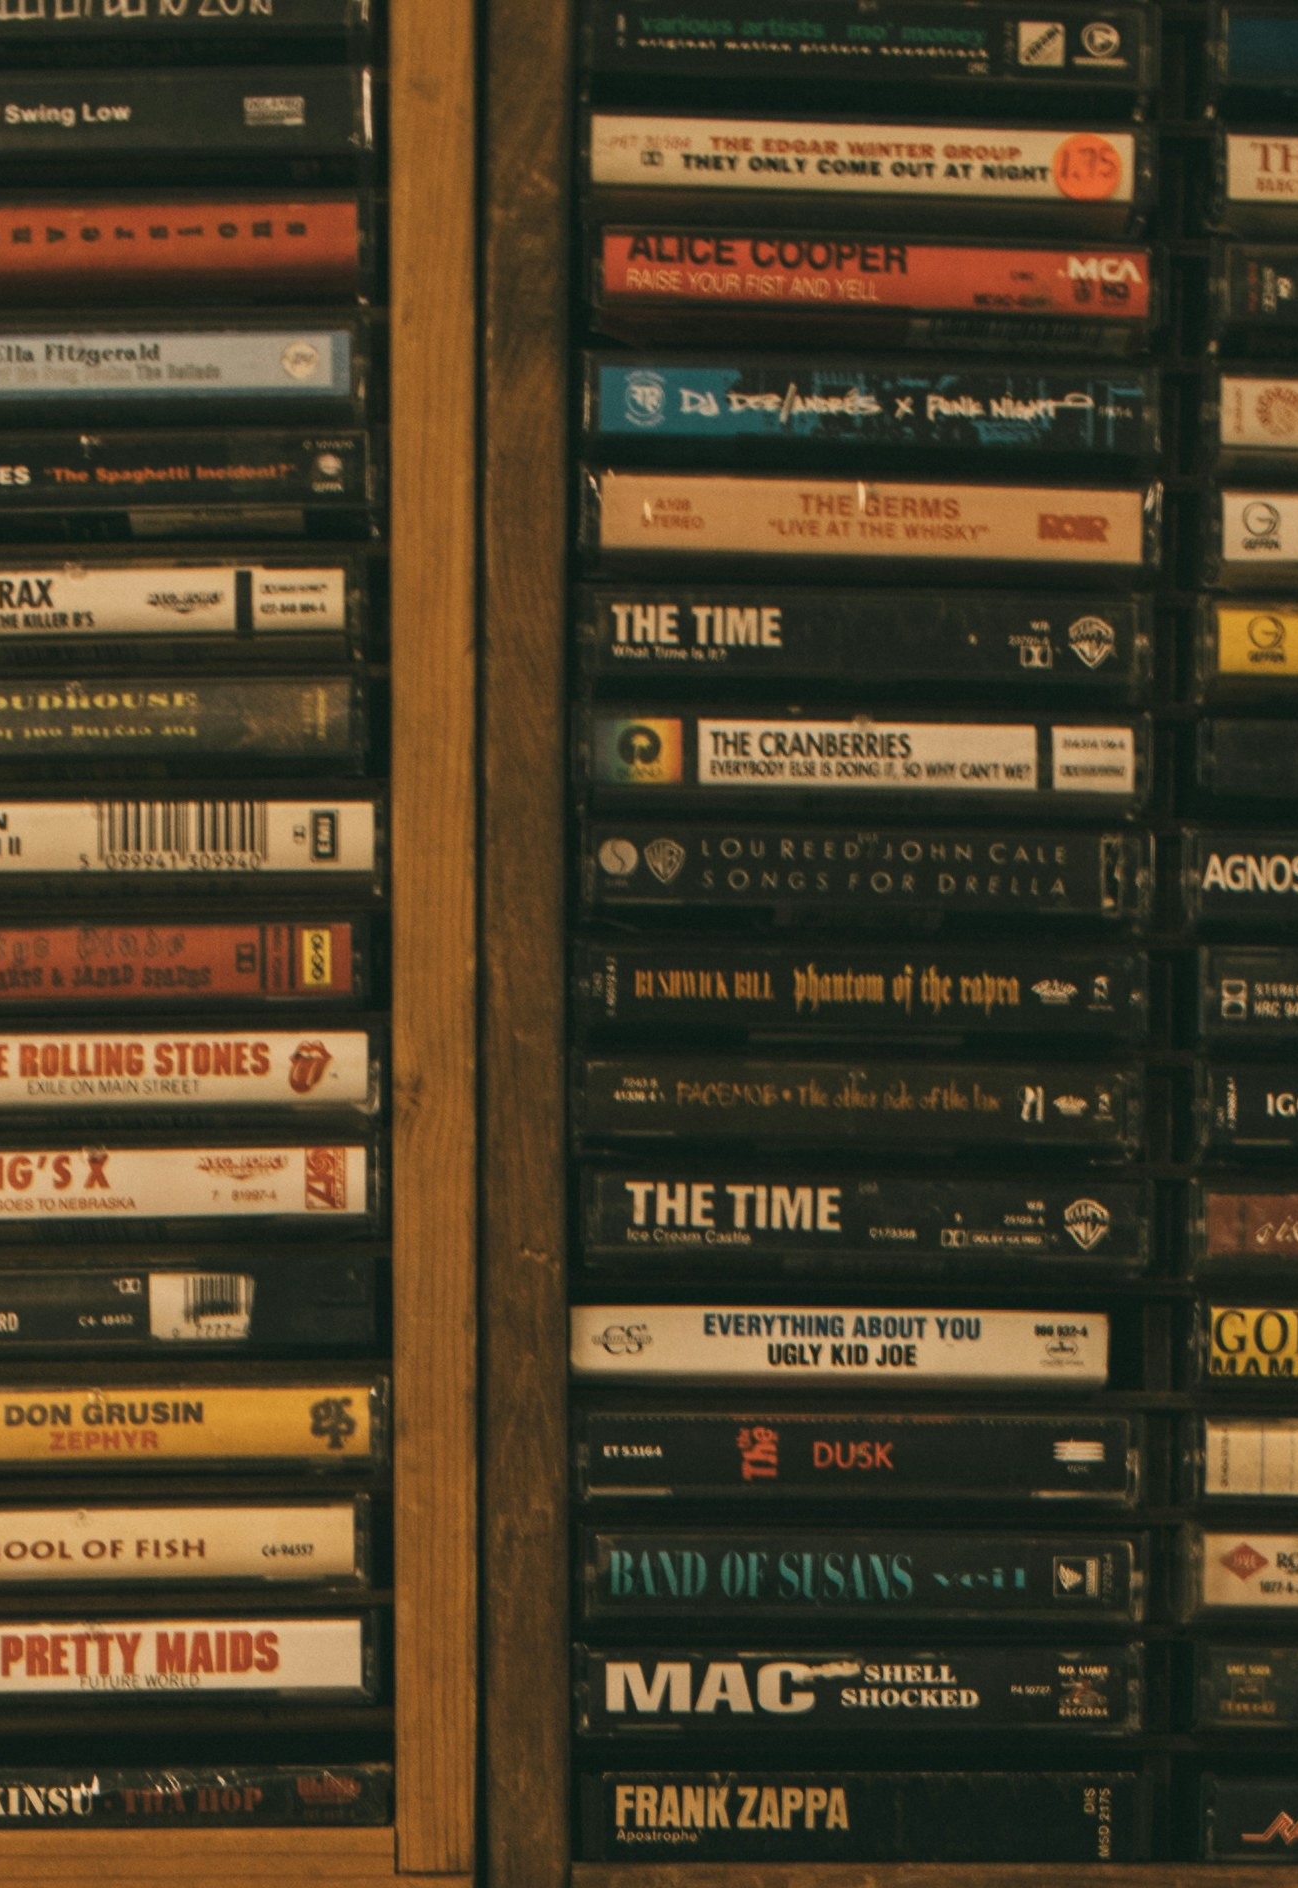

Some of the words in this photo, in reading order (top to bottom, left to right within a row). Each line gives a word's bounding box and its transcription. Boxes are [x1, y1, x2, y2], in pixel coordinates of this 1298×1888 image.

[4, 102, 73, 129] Swing
[79, 103, 130, 123] Low
[682, 154, 742, 172] THEY
[749, 155, 811, 175] ONLY
[818, 158, 885, 178] COME
[891, 159, 937, 178] OUT
[943, 161, 975, 179] AT
[981, 162, 1050, 183] NIGHT
[21, 612, 69, 629] KILLER
[612, 604, 683, 644] THE
[692, 605, 782, 647] TIME
[711, 731, 754, 756] THE
[759, 731, 911, 758] CRANBERRIES
[8, 836, 21, 855] II
[19, 1044, 144, 1077] ROLLING
[155, 1044, 269, 1075] STONES
[704, 1313, 845, 1338] EVERYTHING
[852, 1316, 928, 1339] ABOUT
[935, 1317, 981, 1340] YOU
[768, 1344, 824, 1366] UGLY
[831, 1344, 869, 1366] KID
[876, 1344, 918, 1366] JOE
[4, 1404, 70, 1426] DON
[82, 1402, 204, 1425] GRUSIN
[50, 1430, 159, 1451] ZEPHYR
[0, 1634, 141, 1677] PRETTY
[157, 1632, 279, 1673] MAIDS
[605, 1662, 817, 1713] MAC
